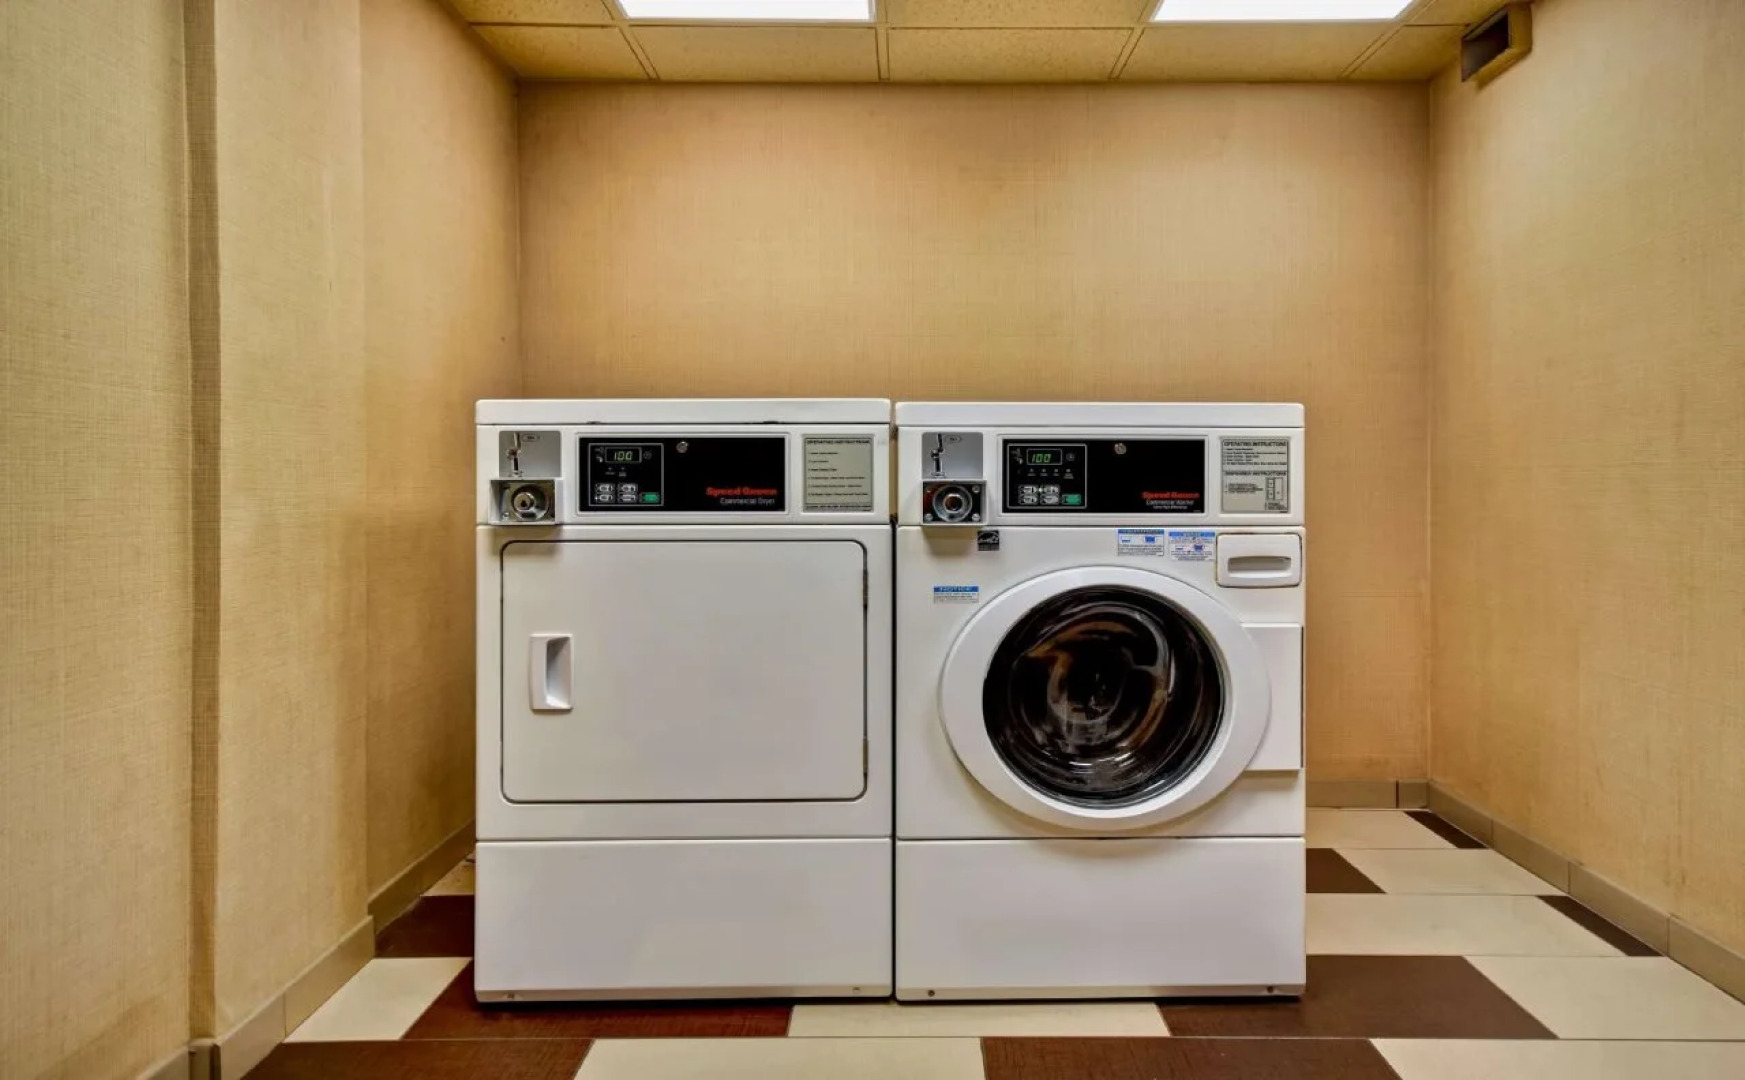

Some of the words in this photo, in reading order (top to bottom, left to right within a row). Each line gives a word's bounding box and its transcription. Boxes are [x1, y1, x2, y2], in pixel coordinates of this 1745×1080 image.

[614, 450, 633, 461] 100
[1032, 453, 1052, 463] 100
[706, 487, 741, 497] Speed
[742, 487, 777, 496] Queen
